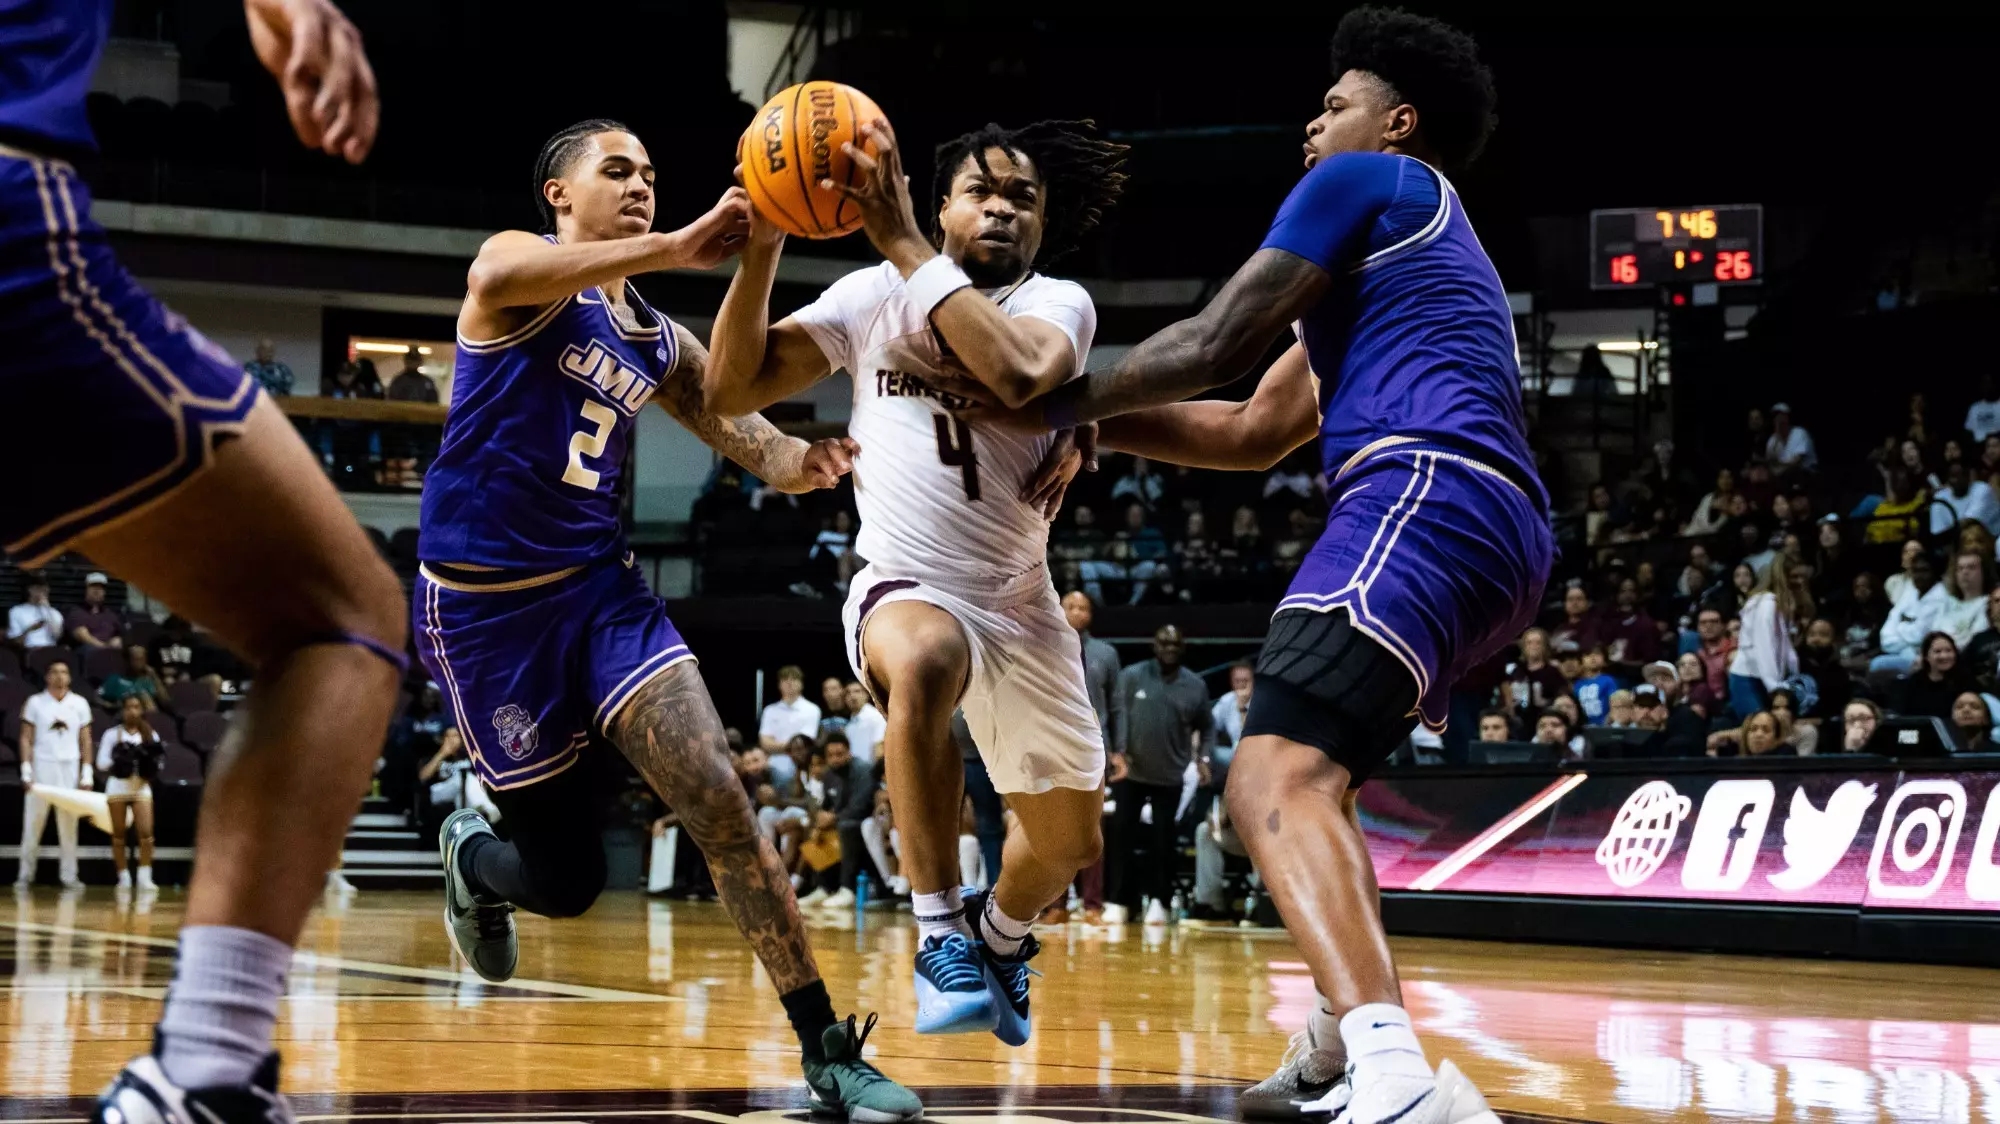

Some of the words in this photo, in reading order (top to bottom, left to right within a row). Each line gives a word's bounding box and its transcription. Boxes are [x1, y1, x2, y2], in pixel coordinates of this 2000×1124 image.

[763, 105, 787, 175] NCAA
[809, 88, 838, 187] Wilson
[1611, 254, 1639, 284] 16
[1714, 251, 1753, 281] 26
[560, 340, 656, 415] JMU
[561, 398, 617, 491] 2
[932, 411, 983, 502] 4
